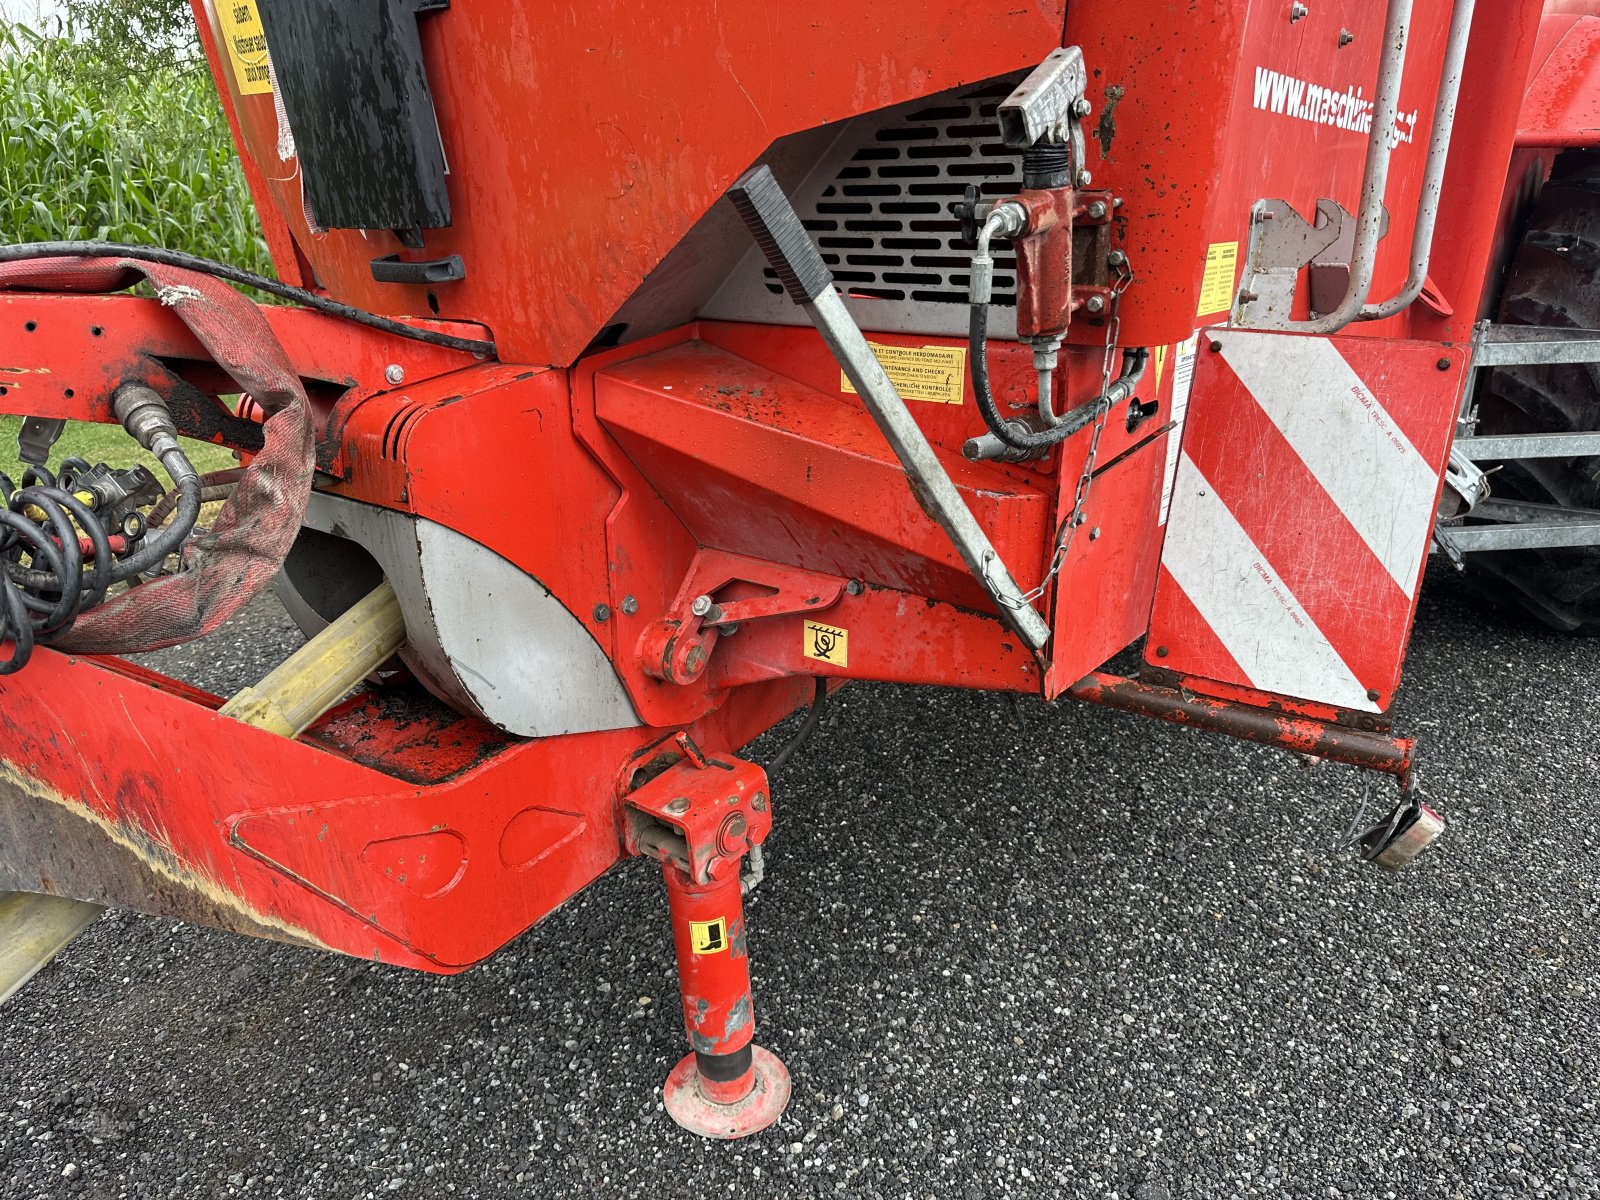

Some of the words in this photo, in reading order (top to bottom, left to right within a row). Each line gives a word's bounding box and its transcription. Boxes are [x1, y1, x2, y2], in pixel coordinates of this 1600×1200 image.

[913, 352, 954, 360] HEBDOMADAIRE
[1350, 386, 1372, 409] BICMA
[1253, 562, 1272, 585] BICMA
